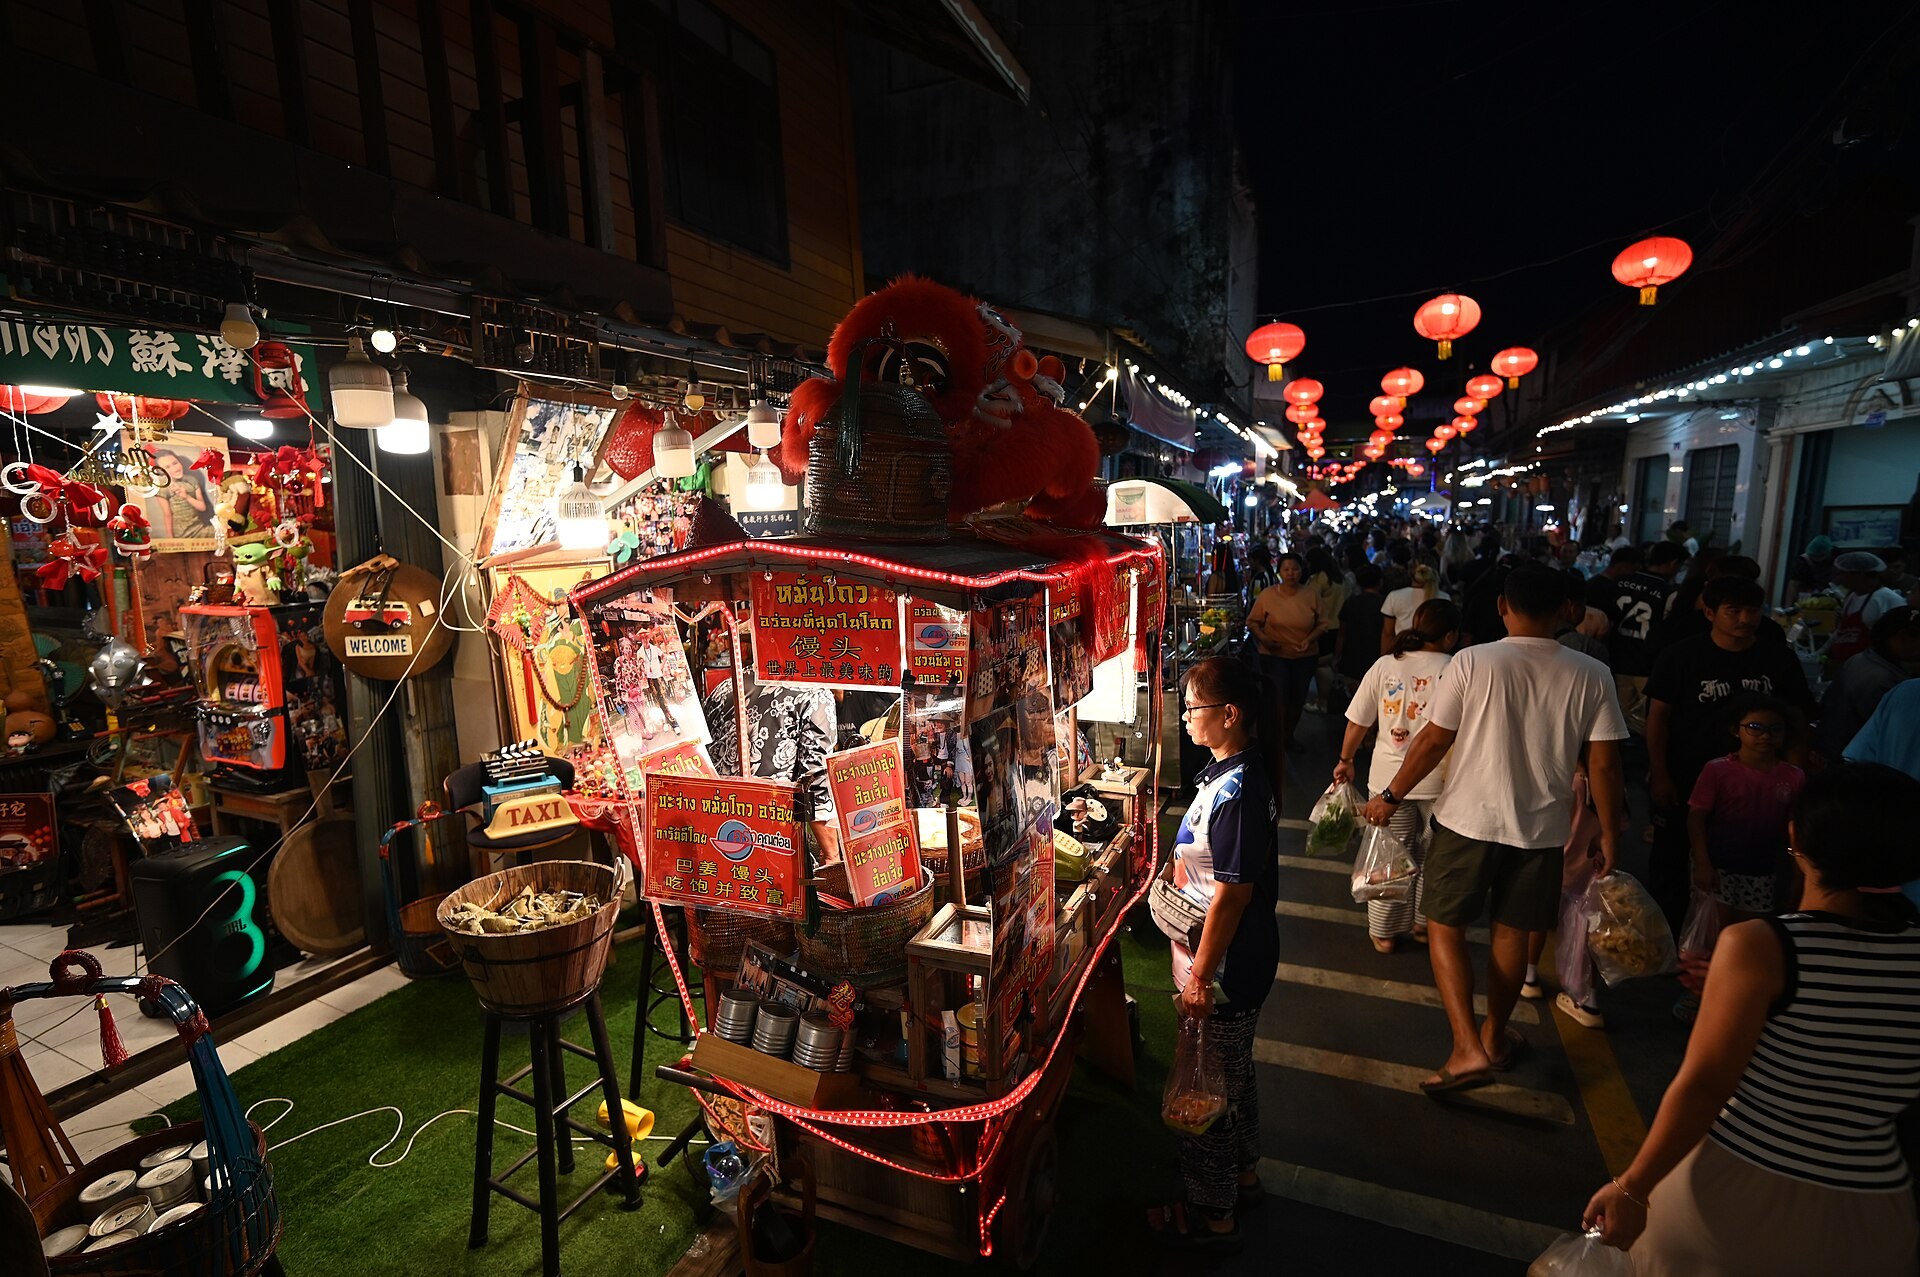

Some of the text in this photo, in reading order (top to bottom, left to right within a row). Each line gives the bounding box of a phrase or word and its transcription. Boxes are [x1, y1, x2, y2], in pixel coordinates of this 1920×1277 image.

[759, 610, 893, 636] อร่อยที่สุดในโลก
[349, 638, 407, 654] WELCOME
[789, 635, 863, 661] 馒头
[766, 660, 894, 682] 世界上最美味的
[506, 800, 563, 828] TAXI
[658, 789, 795, 823] บะจ่าง หมั่นโถว อร่อย
[877, 815, 901, 827] OFFICIAL
[675, 858, 775, 885] 巴姜 馒头
[664, 874, 785, 906] 吃饱并致富
[223, 918, 247, 936] JBL
